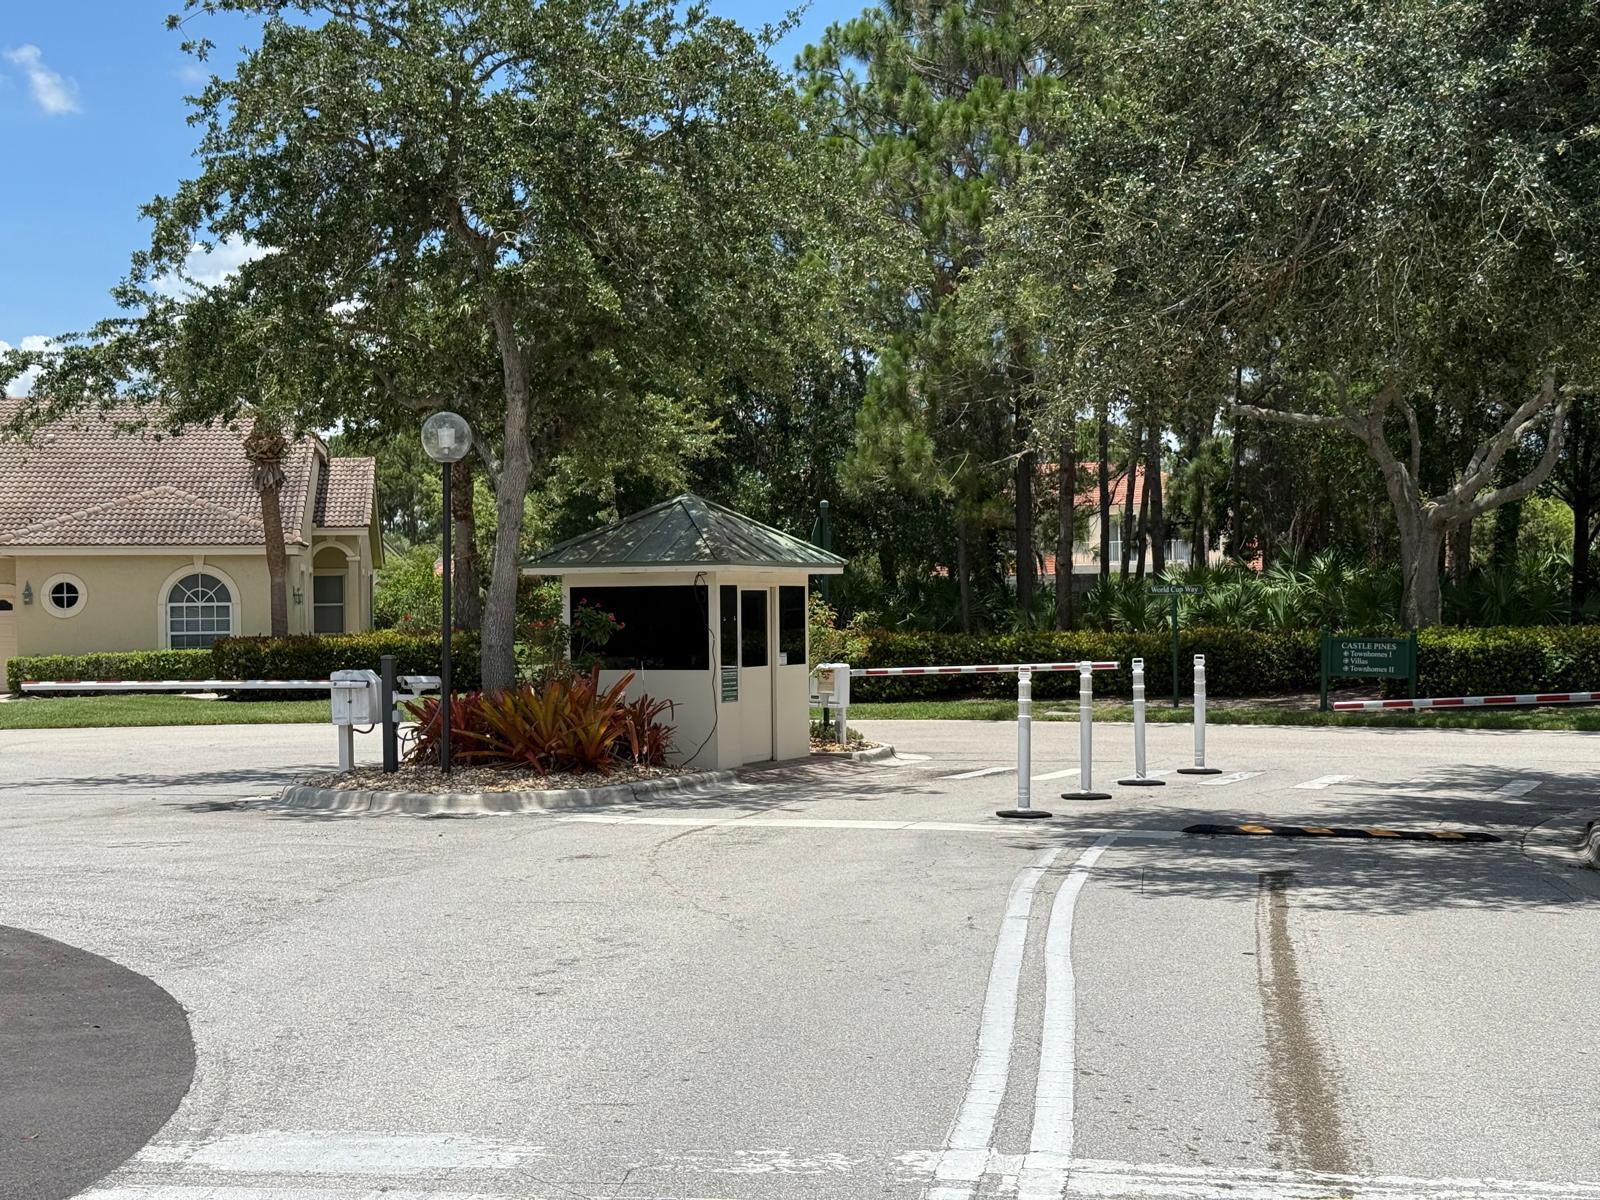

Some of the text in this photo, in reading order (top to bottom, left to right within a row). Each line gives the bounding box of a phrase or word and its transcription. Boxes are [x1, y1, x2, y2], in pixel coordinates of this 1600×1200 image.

[1341, 642, 1372, 650] CASTLE
[1349, 650, 1387, 658] Townhomes
[1349, 665, 1387, 673] Townhomes
